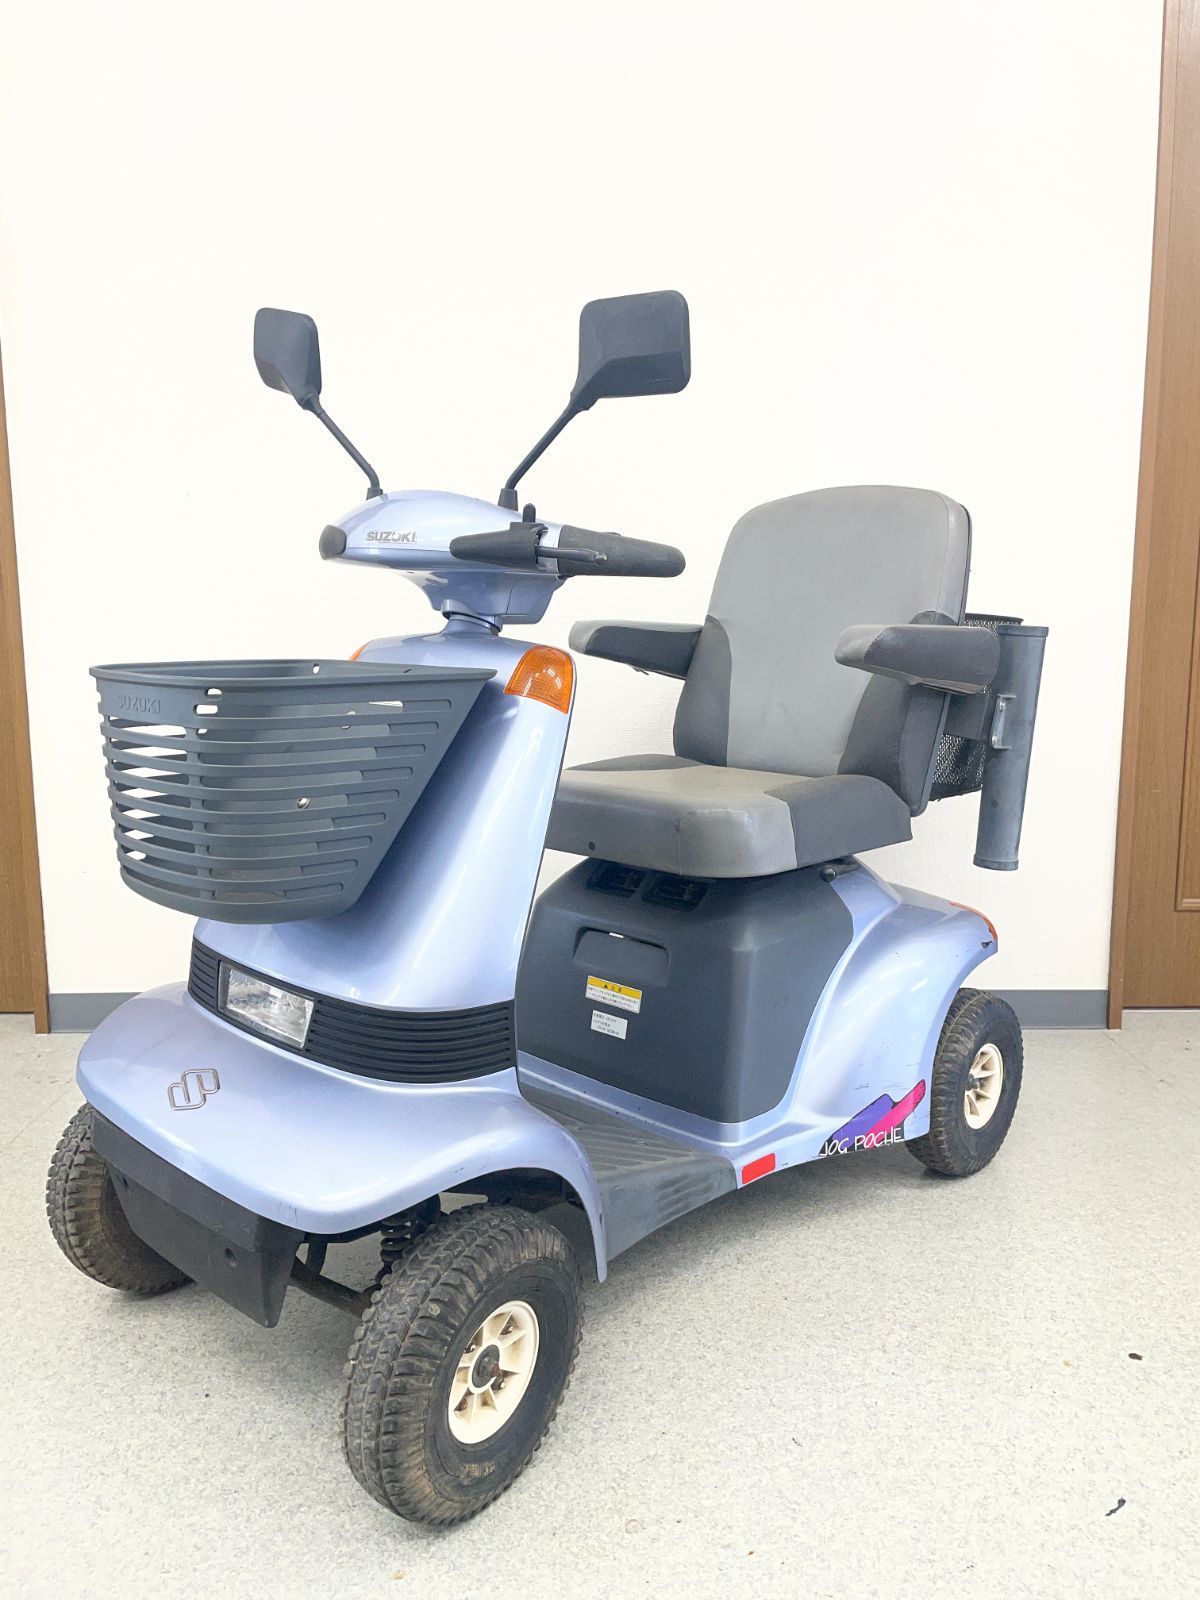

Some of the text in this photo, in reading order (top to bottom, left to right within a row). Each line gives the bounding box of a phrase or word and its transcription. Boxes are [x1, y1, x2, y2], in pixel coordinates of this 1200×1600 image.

[366, 531, 416, 543] SUZUKI
[115, 695, 161, 713] SUZUKI
[819, 1126, 905, 1157] JOG POCHE
